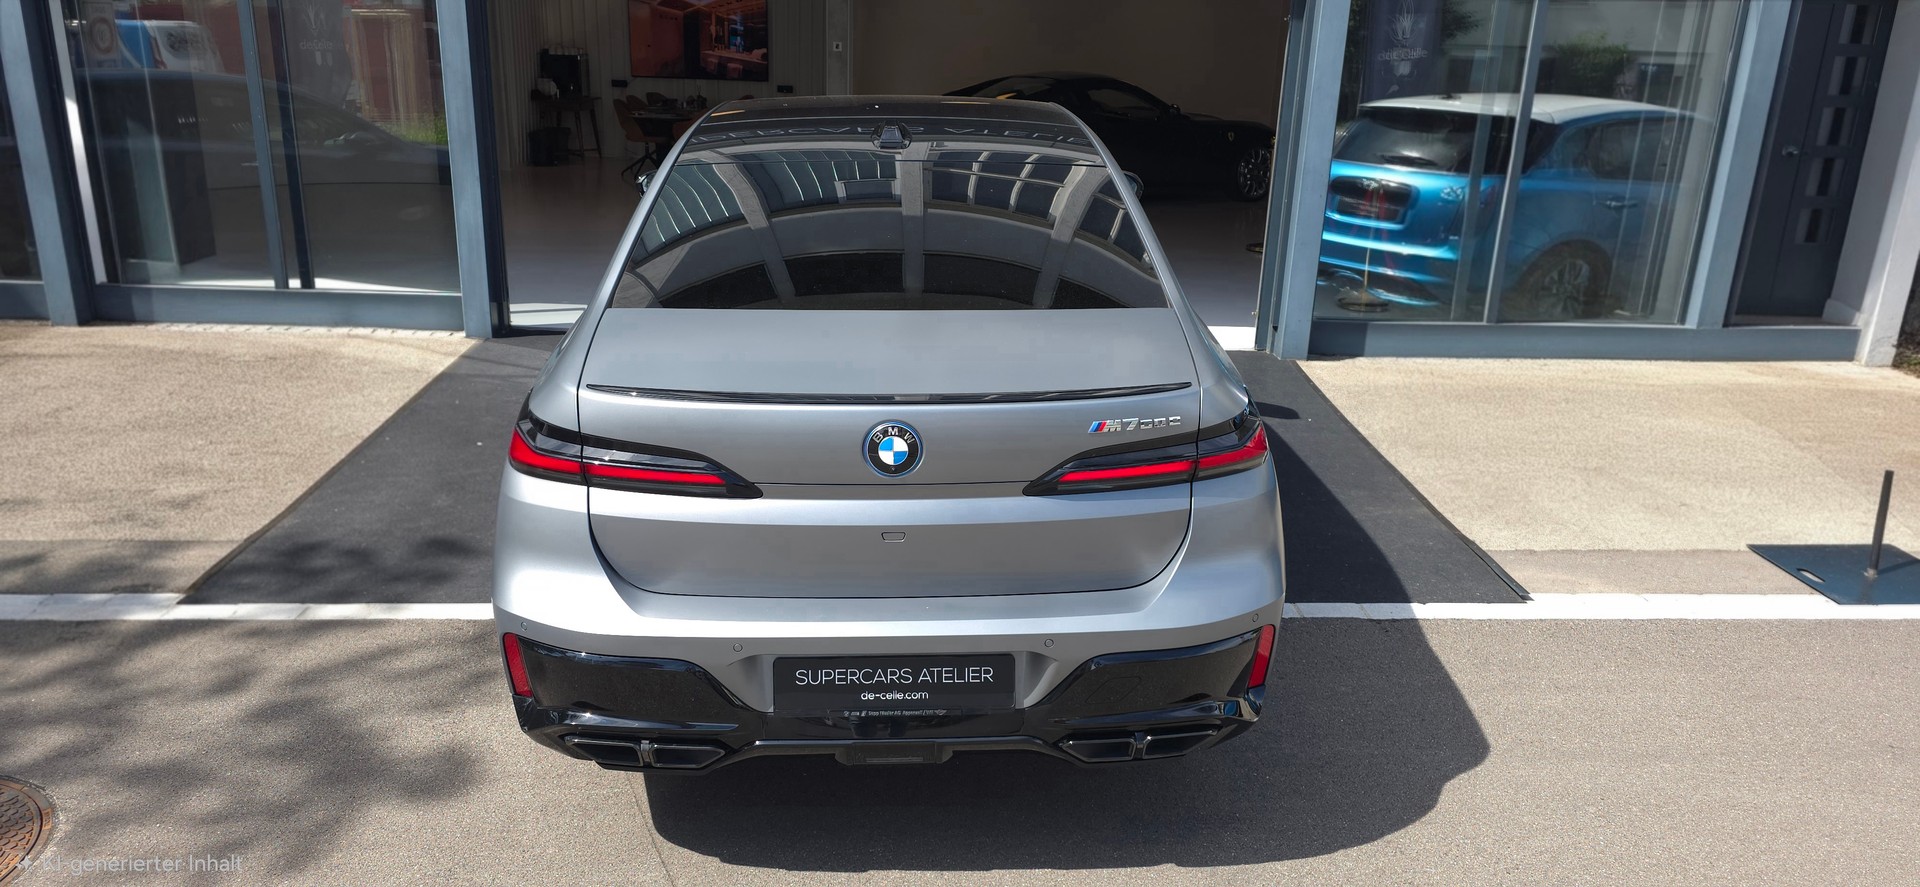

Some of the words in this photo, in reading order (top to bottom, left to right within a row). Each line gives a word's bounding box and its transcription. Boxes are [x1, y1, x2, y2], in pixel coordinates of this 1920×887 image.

[873, 426, 916, 444] BMW
[795, 668, 913, 685] SUPERCARS
[917, 666, 994, 683] ATELIER
[861, 689, 929, 700] de-celle.com
